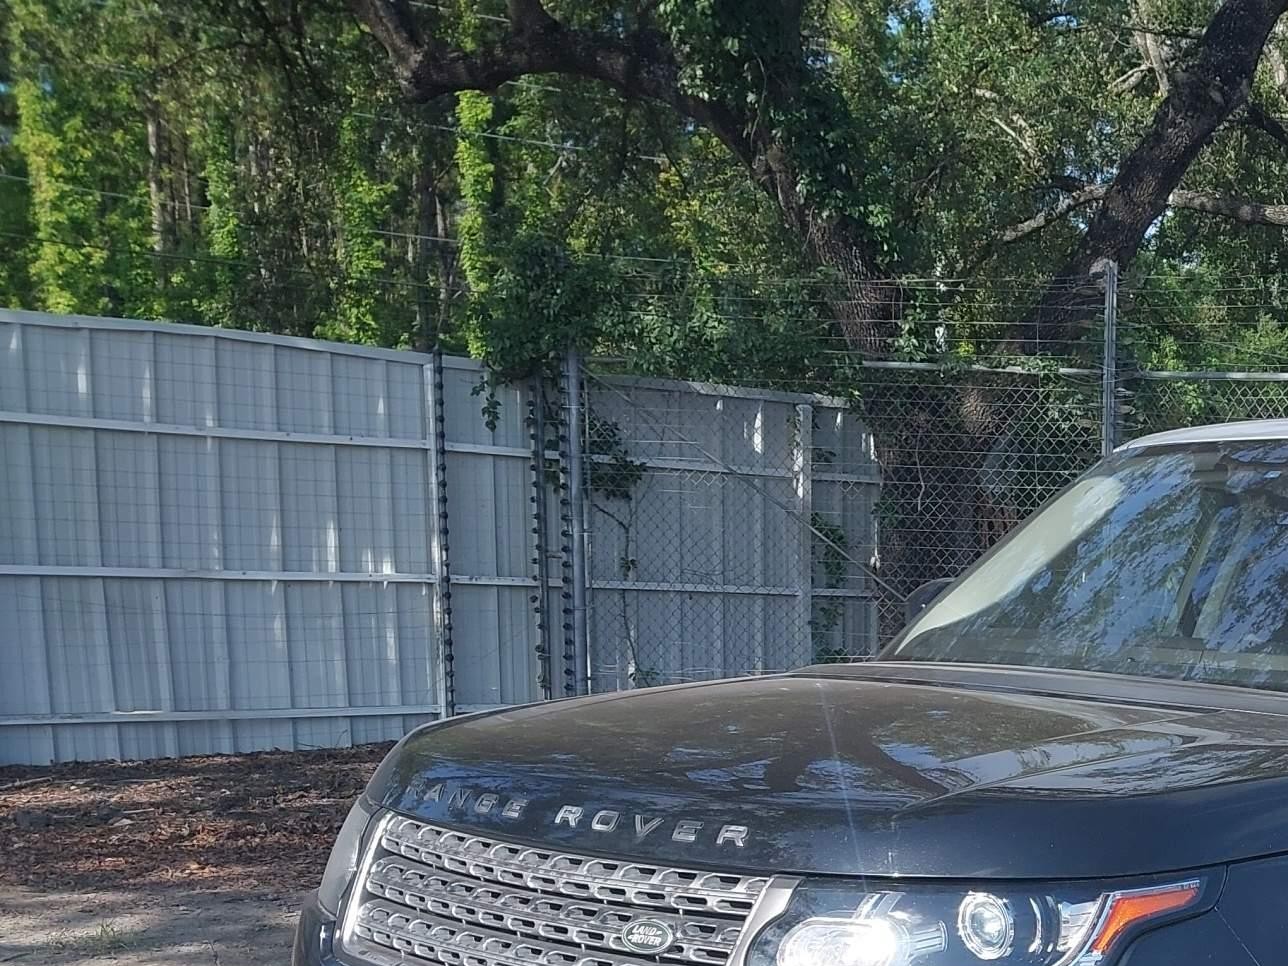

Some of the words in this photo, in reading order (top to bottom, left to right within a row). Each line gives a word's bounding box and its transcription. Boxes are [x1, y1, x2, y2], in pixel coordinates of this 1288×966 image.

[554, 803, 750, 848] ROVER
[632, 925, 657, 936] LAND
[631, 934, 662, 947] ROVER
